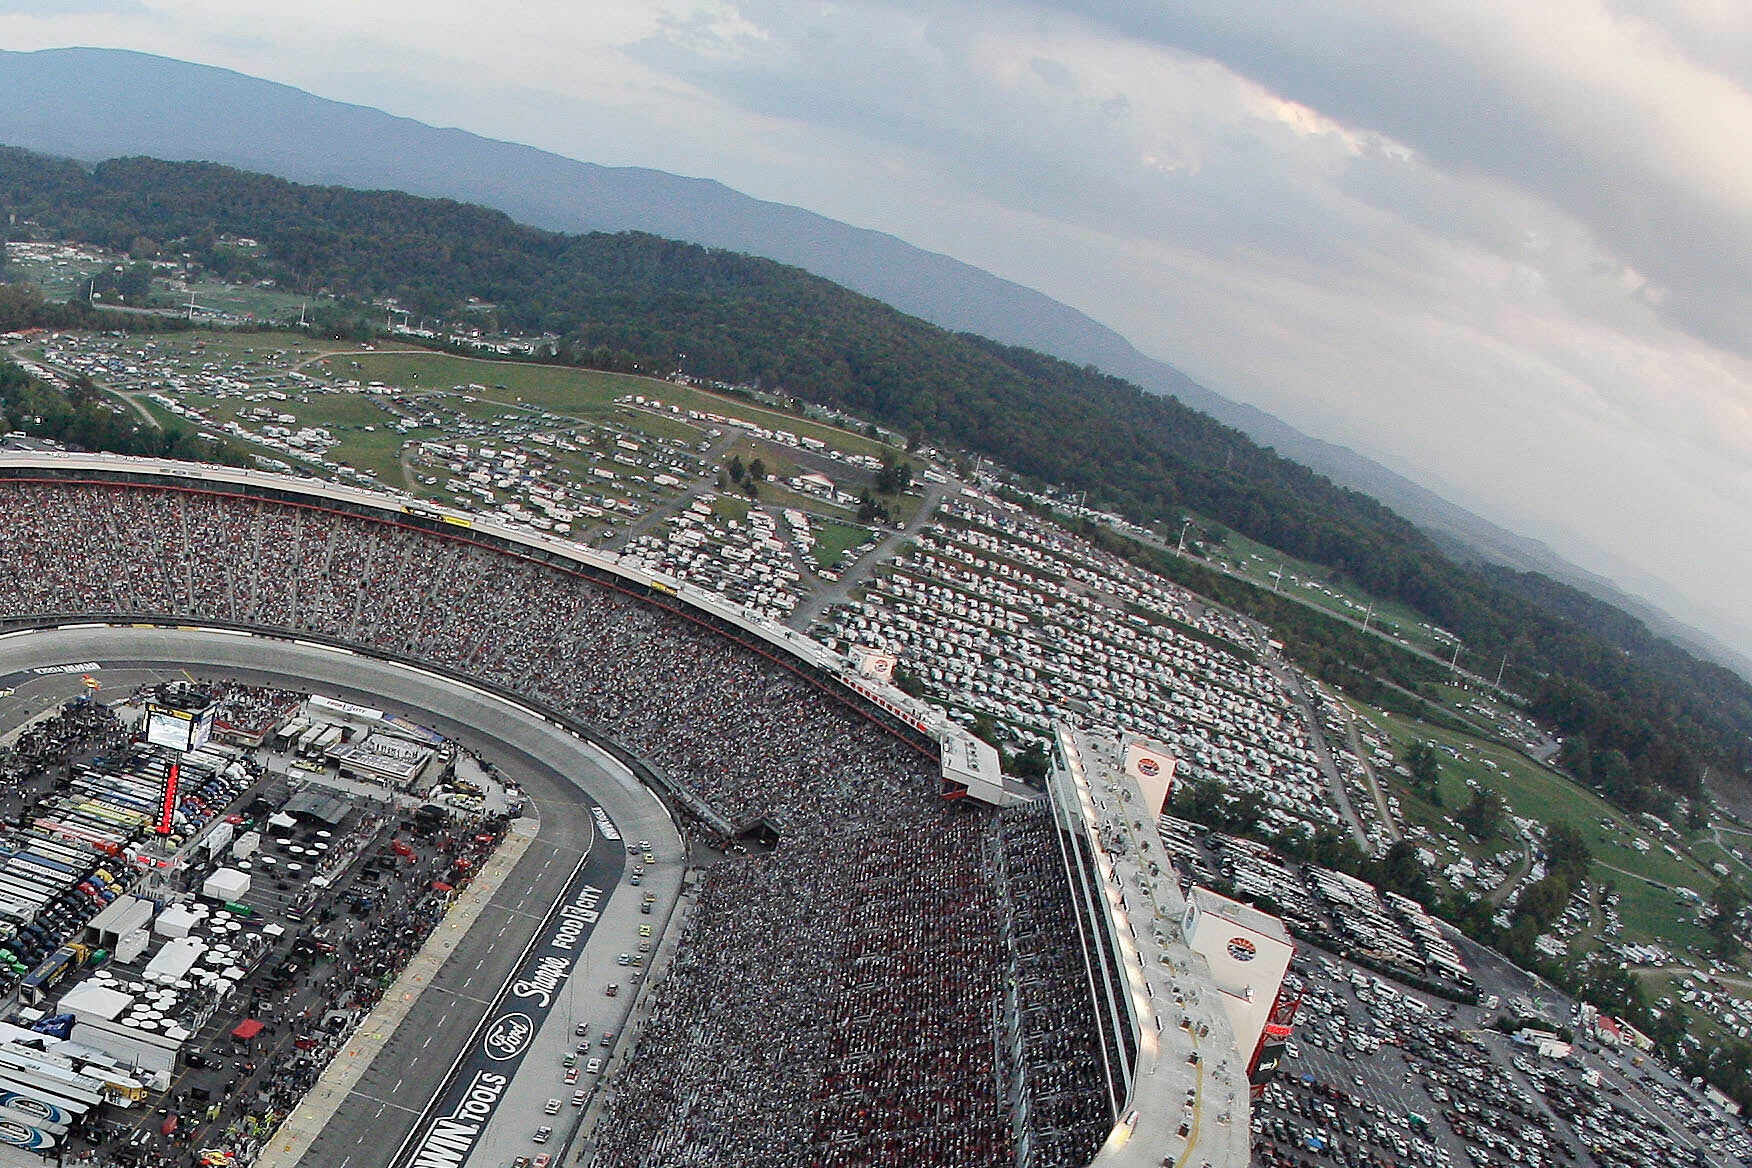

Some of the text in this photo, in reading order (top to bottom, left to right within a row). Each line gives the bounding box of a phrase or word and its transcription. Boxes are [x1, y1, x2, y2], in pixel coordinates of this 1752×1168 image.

[552, 885, 603, 950] FOOD CITY
[513, 956, 571, 1008] Sharpie
[489, 1019, 529, 1053] Ford
[458, 1072, 506, 1121] TOOLS
